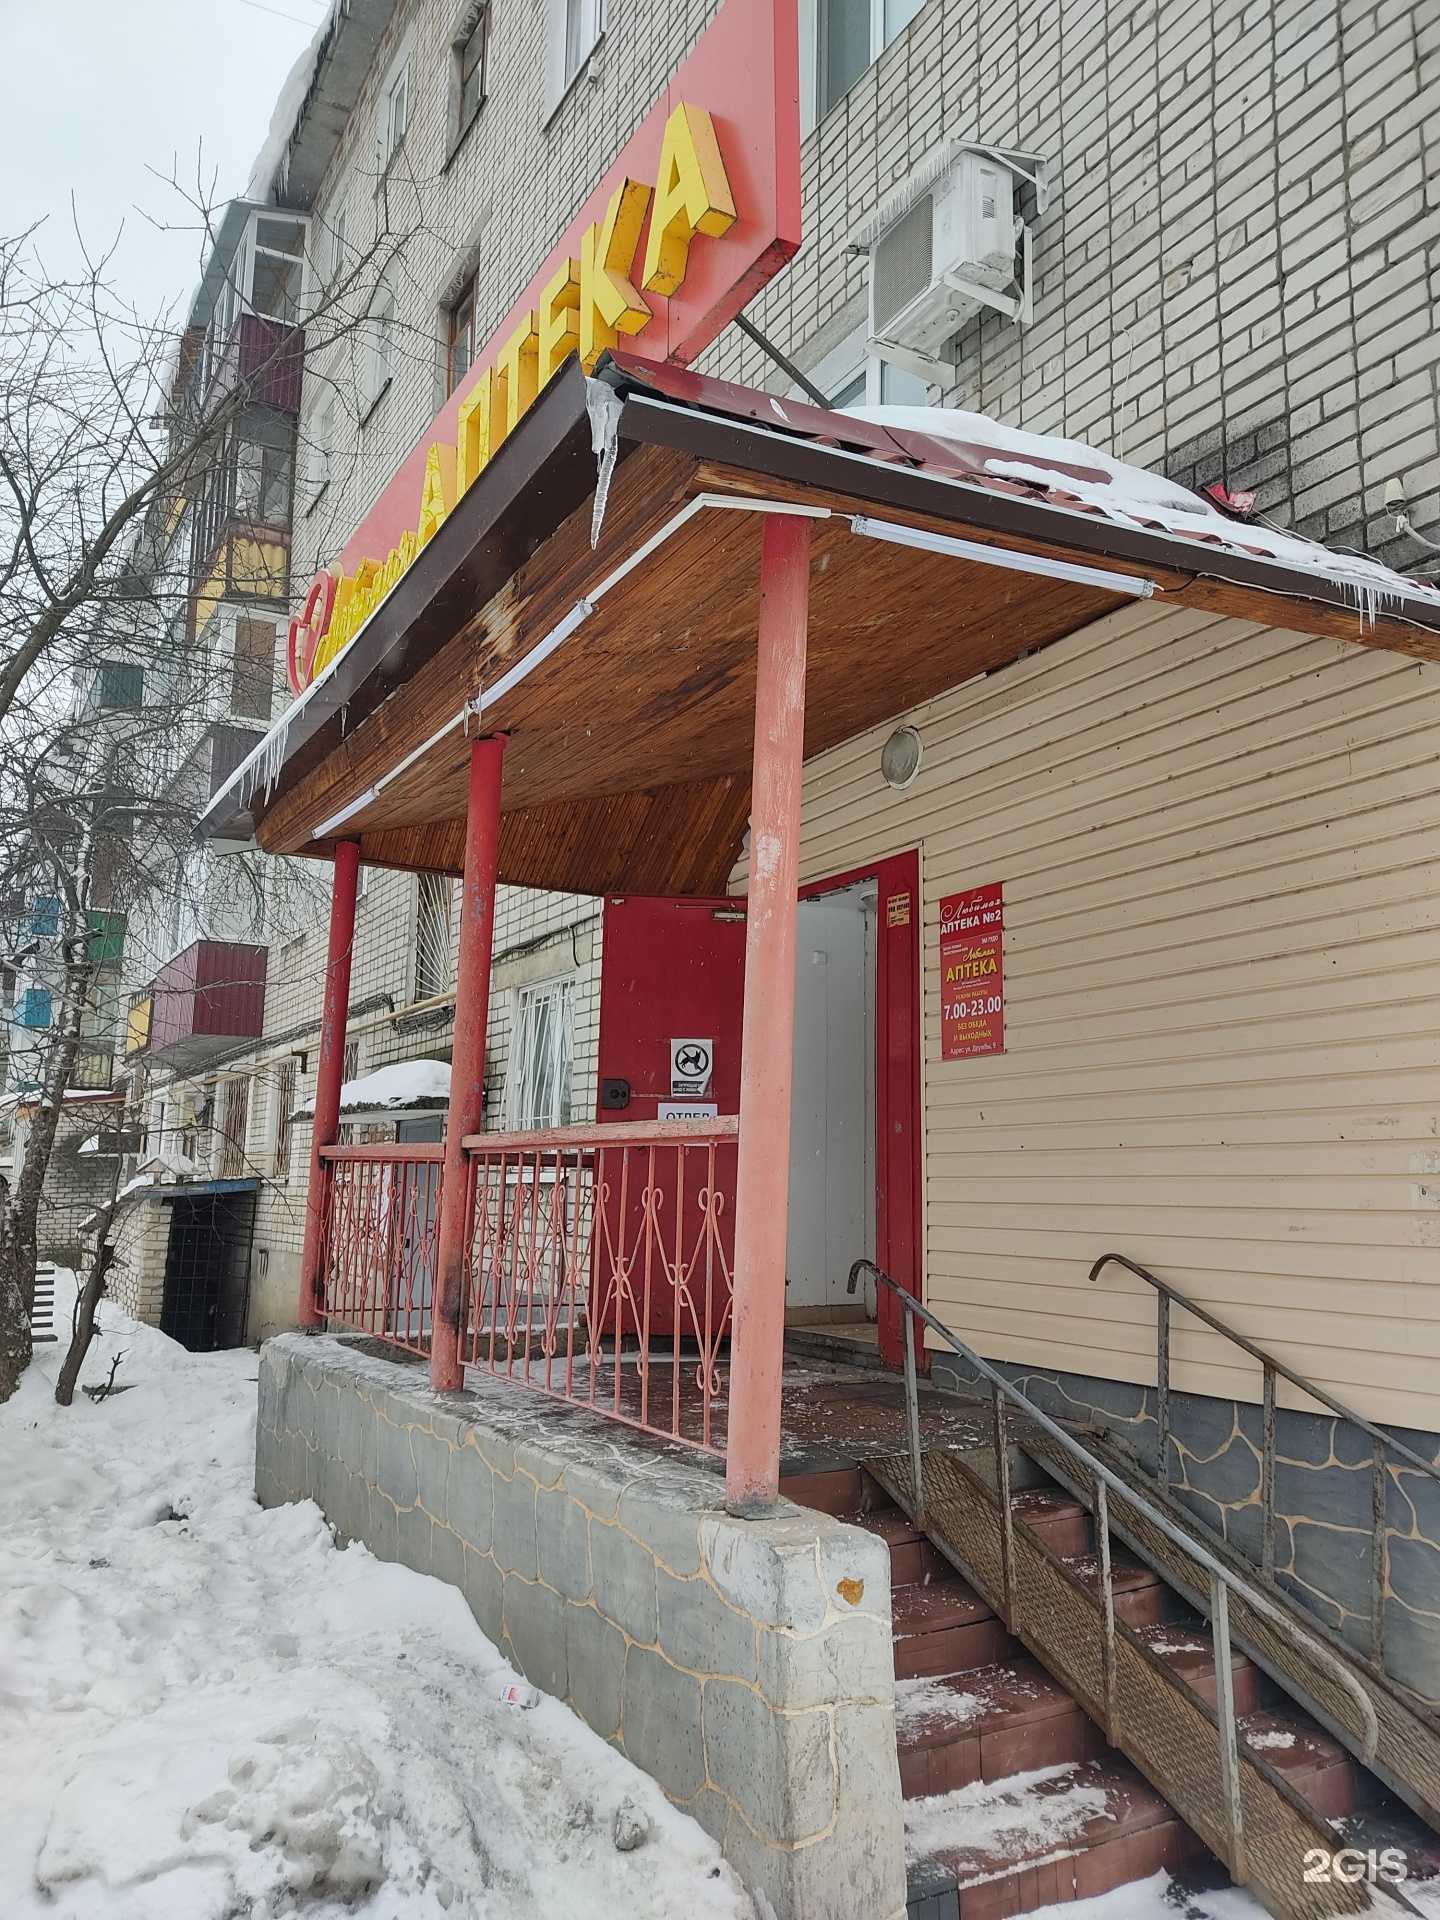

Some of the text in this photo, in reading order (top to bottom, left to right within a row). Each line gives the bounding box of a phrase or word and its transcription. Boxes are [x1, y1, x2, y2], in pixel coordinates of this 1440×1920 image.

[418, 100, 738, 558] АПТЕКА
[941, 895, 1001, 924] Любимая
[941, 909, 1001, 935] АПТЕКА №2
[946, 959, 998, 982] АПТЕКА
[943, 995, 1001, 1020] 7.00-23.00
[968, 1019, 988, 1029] ОБЕДА
